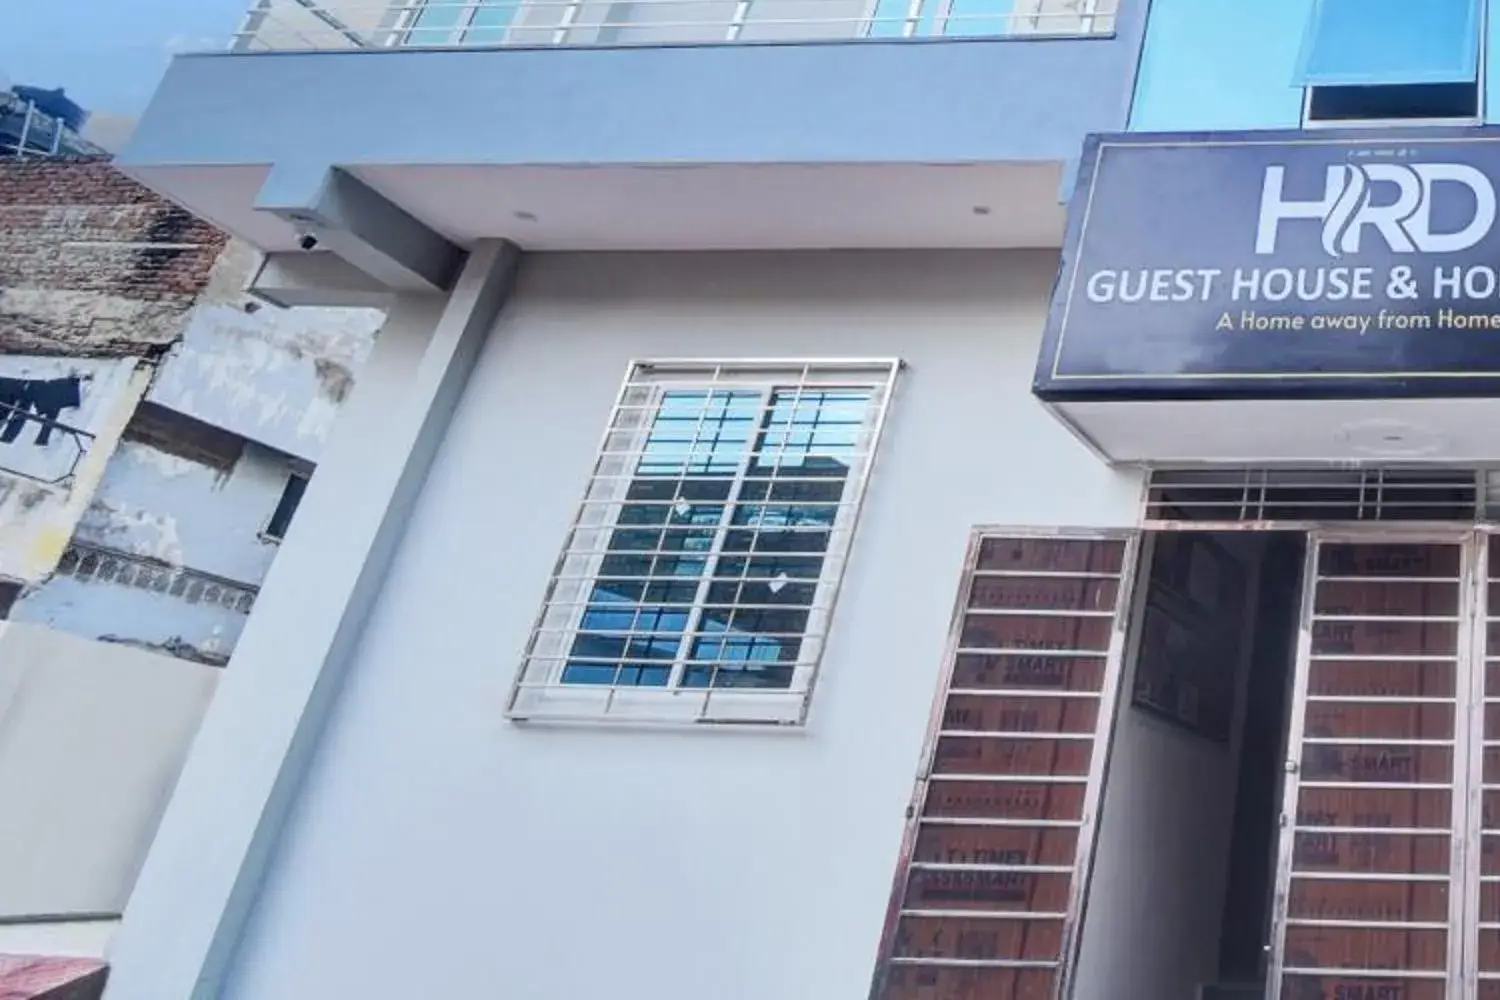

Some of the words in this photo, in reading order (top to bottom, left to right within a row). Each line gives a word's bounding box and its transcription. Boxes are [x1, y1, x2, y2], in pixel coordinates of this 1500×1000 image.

[1254, 162, 1497, 258] HRD
[1086, 267, 1223, 303] GUEST
[1230, 266, 1374, 302] HOUSE
[1386, 264, 1419, 300] &
[1214, 311, 1234, 331] A
[1240, 309, 1306, 331] Home
[1310, 314, 1372, 337] away
[1377, 308, 1432, 330] from
